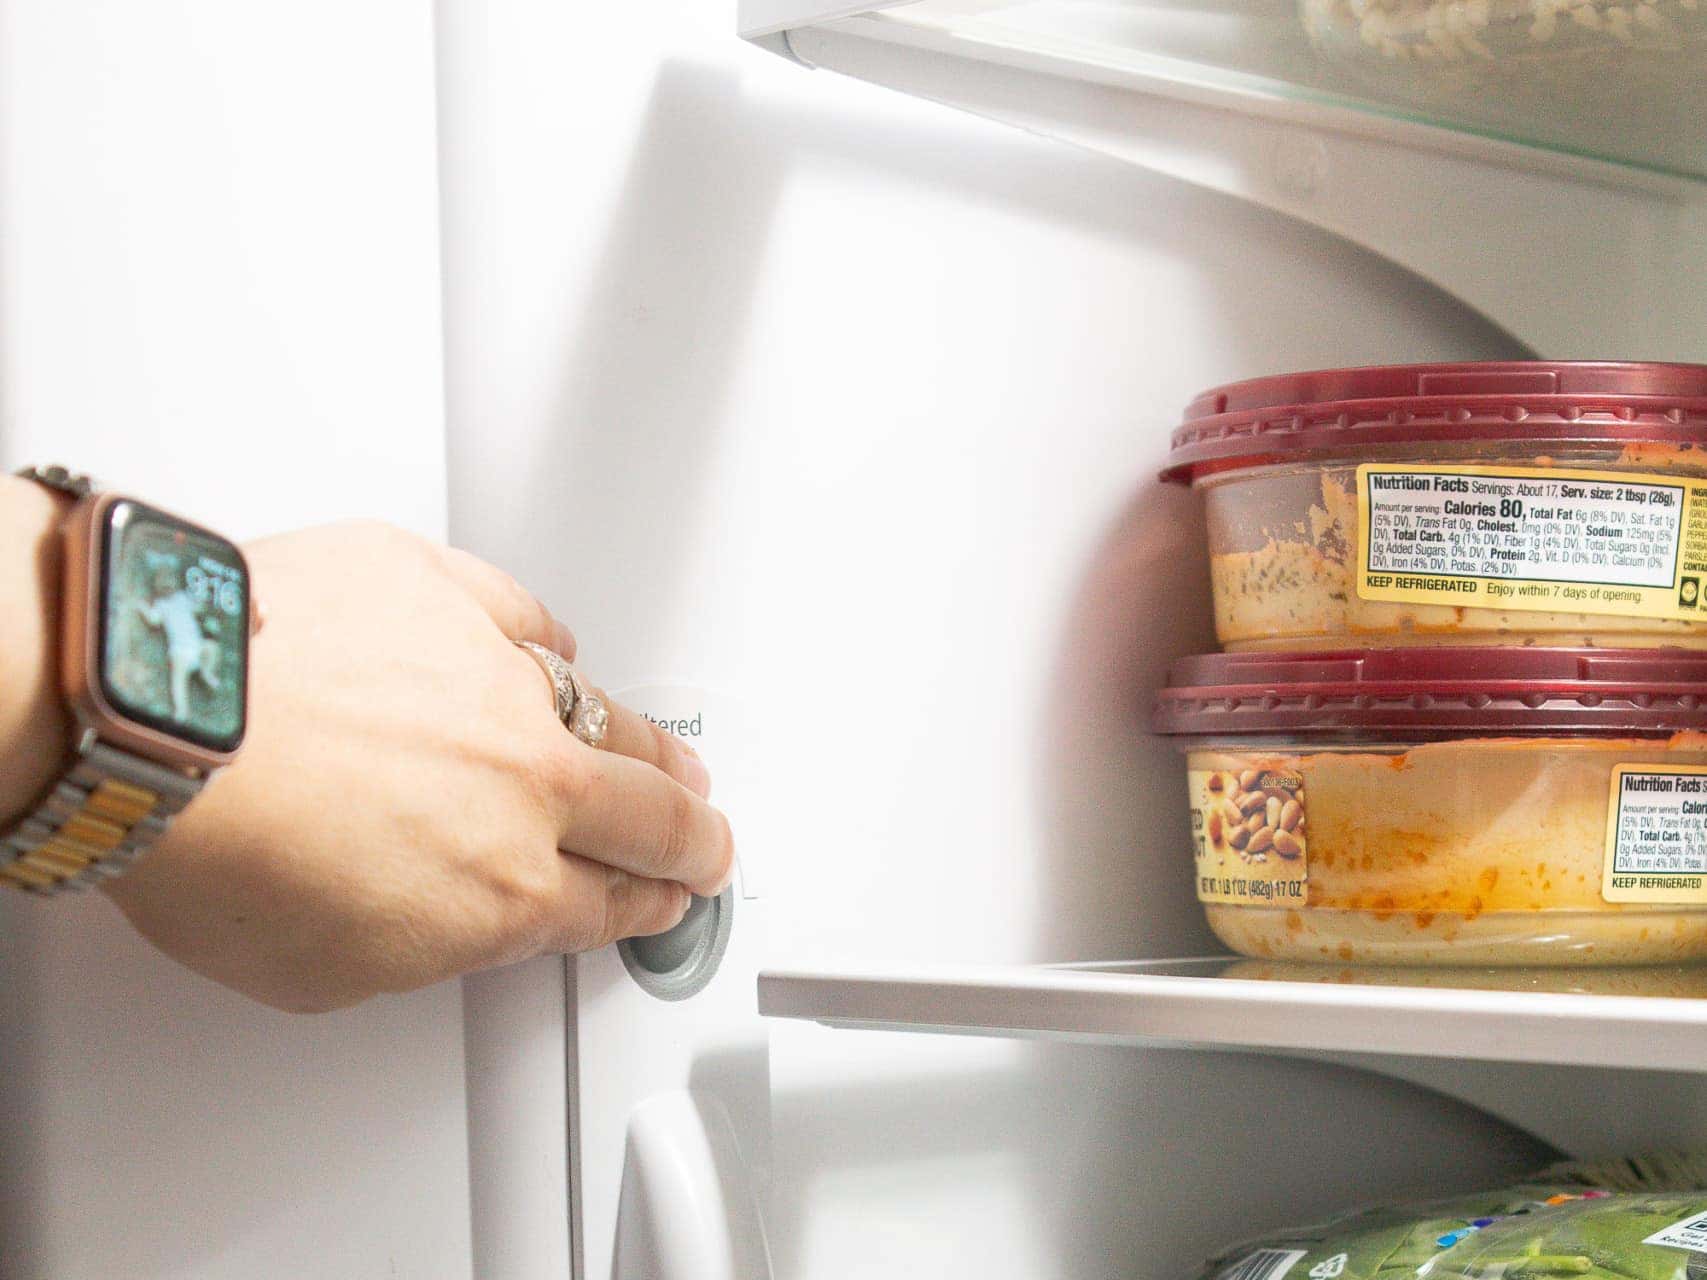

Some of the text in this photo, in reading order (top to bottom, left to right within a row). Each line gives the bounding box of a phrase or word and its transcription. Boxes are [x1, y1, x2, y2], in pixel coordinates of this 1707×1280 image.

[1374, 475, 1430, 491] Nutrition
[1434, 477, 1469, 492] Facts
[1472, 480, 1514, 497] Servings:
[1516, 483, 1543, 497] About
[1561, 484, 1587, 499] Serv.
[1590, 486, 1614, 500] size:
[1616, 488, 1623, 500] 2
[1625, 488, 1646, 504] tbsp
[1374, 502, 1400, 513] Amount
[1400, 504, 1412, 516] per
[1445, 500, 1496, 517] Calories
[1500, 499, 1527, 521] 80,
[1529, 507, 1553, 520] Total
[1556, 508, 1573, 521] Fat
[1575, 510, 1587, 523] 6g
[1650, 514, 1662, 527] Fat
[1666, 516, 1675, 529] 1g
[1374, 514, 1392, 528] (5%
[1415, 516, 1440, 528] Trans
[1442, 517, 1457, 529] Fat
[1477, 519, 1518, 533] Cholest.
[1586, 525, 1623, 538] Sodium
[1626, 527, 1654, 542] 125mg
[1393, 529, 1416, 541] Total
[1419, 530, 1446, 542] Carb.
[1448, 532, 1460, 545] 4g
[1504, 535, 1526, 547] Fiber
[1529, 536, 1540, 549] 1g
[1585, 539, 1605, 550] Total
[1608, 540, 1638, 554] Sugars
[1639, 542, 1650, 555] 0g
[1373, 542, 1384, 554] 0g
[1386, 542, 1412, 554] Added
[1451, 545, 1467, 558] 0%
[1490, 548, 1525, 561] Protein
[1562, 552, 1569, 563] D
[1612, 554, 1645, 567] Calcium
[1391, 557, 1408, 568] Iron
[1410, 557, 1428, 570] (4%
[1366, 576, 1392, 587] KEEP
[1395, 577, 1478, 593] REFRIGERATED
[1487, 582, 1515, 597] Enjoy
[1518, 584, 1550, 597] within
[1553, 586, 1560, 597] 7
[1563, 586, 1587, 600] days
[1590, 588, 1601, 599] of
[1625, 776, 1673, 792] Nutrition
[1675, 777, 1701, 793] Facts
[1623, 804, 1646, 813] Amount
[1647, 806, 1657, 815] per
[1659, 817, 1679, 828] Trans
[1680, 817, 1692, 829] Fat
[1639, 830, 1660, 841] Total
[1662, 830, 1681, 842] Carb.
[1632, 844, 1656, 855] Added
[1637, 857, 1652, 868] Iron
[1249, 880, 1274, 900] (482g)
[1276, 881, 1287, 896] 17
[1289, 881, 1303, 897] OZ
[1612, 877, 1702, 889] KEEP REFRIGERATED
